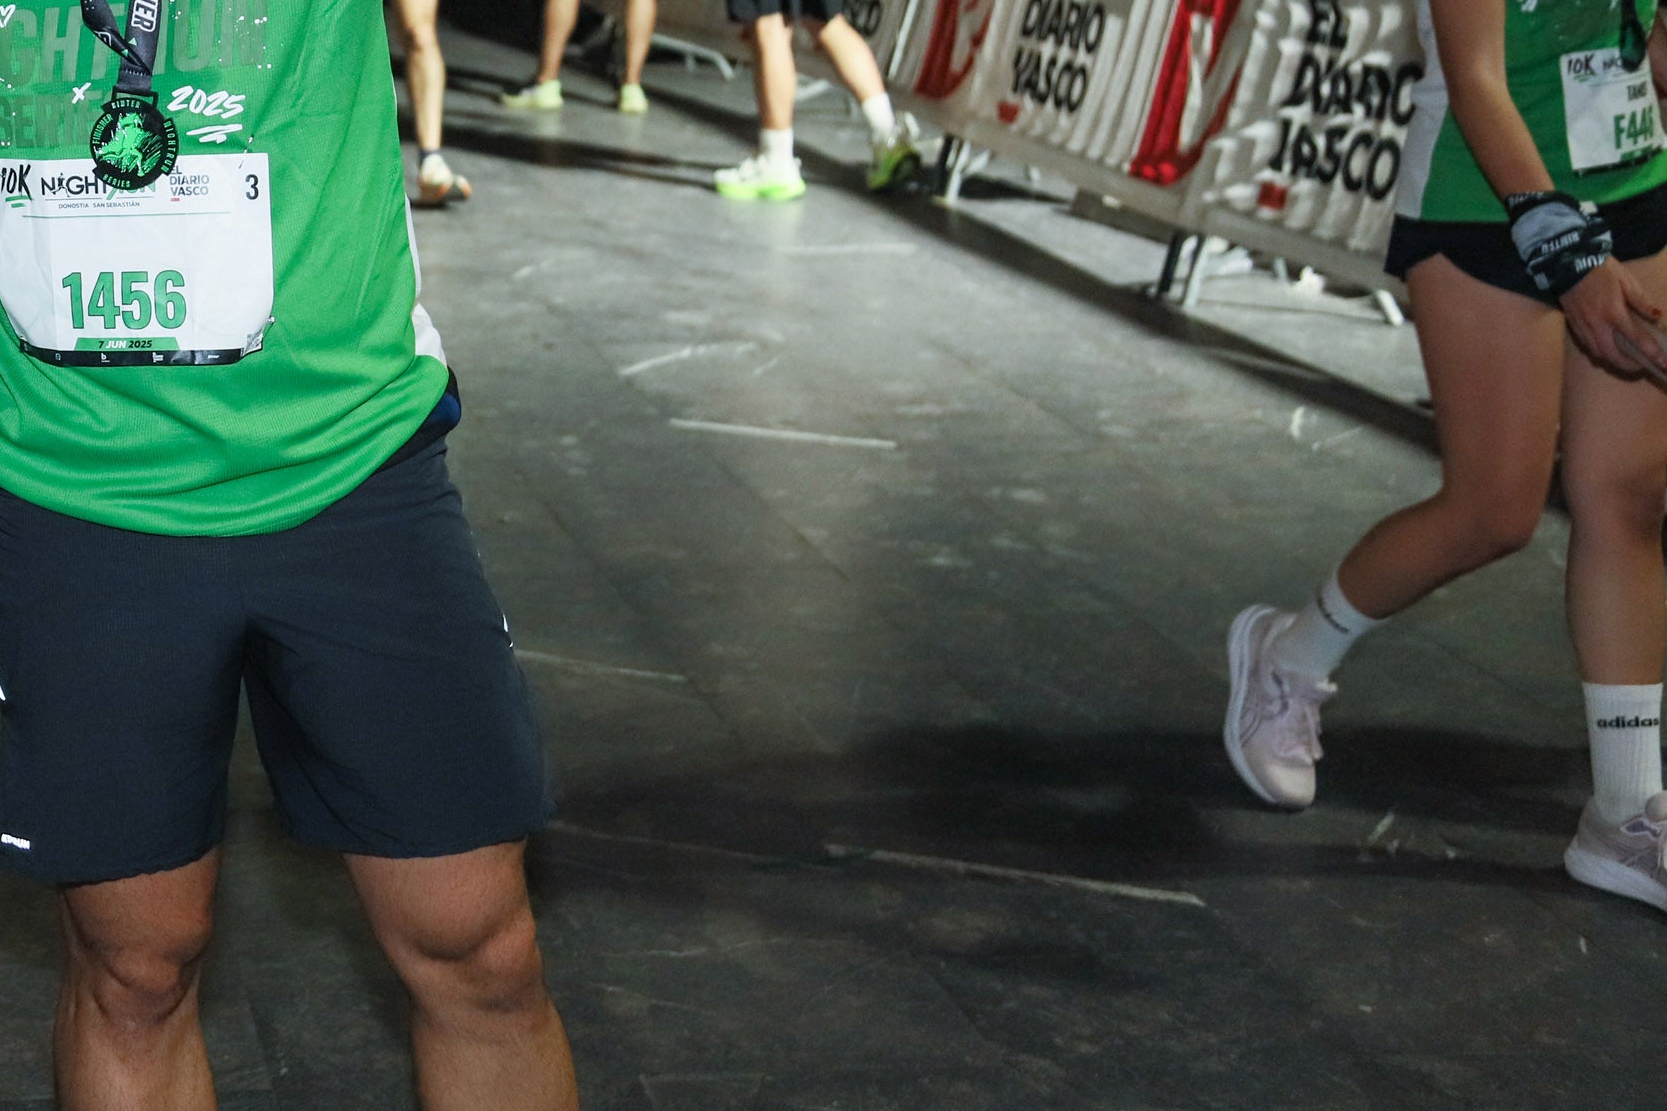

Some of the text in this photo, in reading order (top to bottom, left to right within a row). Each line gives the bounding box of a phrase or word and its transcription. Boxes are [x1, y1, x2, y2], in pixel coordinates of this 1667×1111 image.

[1013, 45, 1088, 113] VASCO
[167, 84, 246, 120] 2025
[92, 113, 114, 144] FINISHER
[161, 120, 177, 173] NIGHTRUN
[0, 164, 32, 200] 10K
[170, 175, 210, 185] DIARIO
[171, 185, 209, 196] VASCO
[245, 174, 259, 200] 3
[58, 202, 89, 210] DONOSTIA
[62, 269, 187, 330] 1456
[98, 340, 153, 349] 7 JUN 2025
[1596, 715, 1660, 730] adidas
